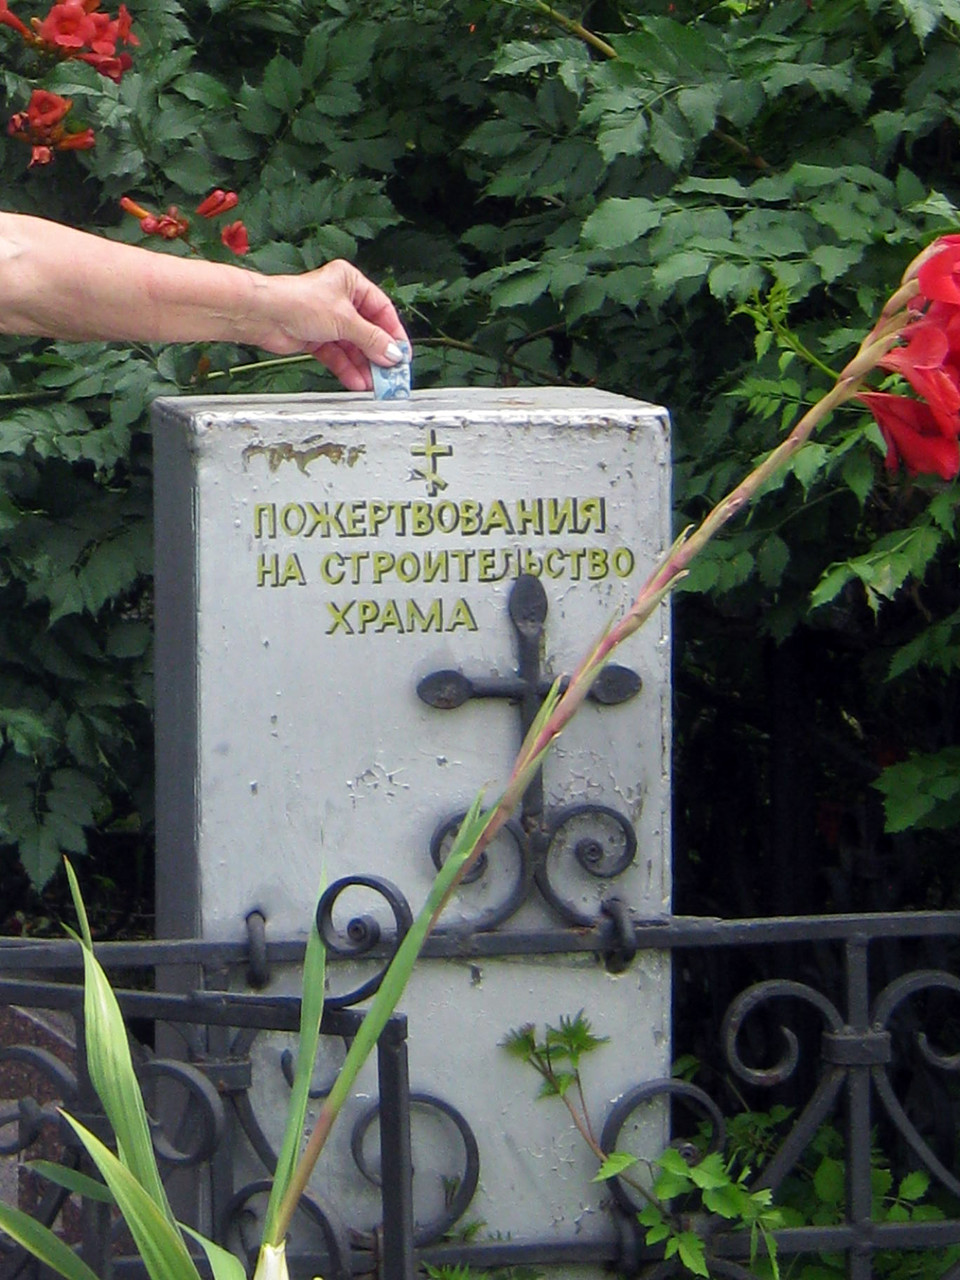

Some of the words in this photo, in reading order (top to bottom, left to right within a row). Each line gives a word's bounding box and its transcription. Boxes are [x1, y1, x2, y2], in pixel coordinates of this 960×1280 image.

[253, 497, 606, 538] ПОЖЕРТВОВАНИЯ
[257, 552, 306, 587] НА
[320, 547, 635, 584] СТРОИТЕЛЬСТВО
[325, 598, 478, 634] ХРАМА
